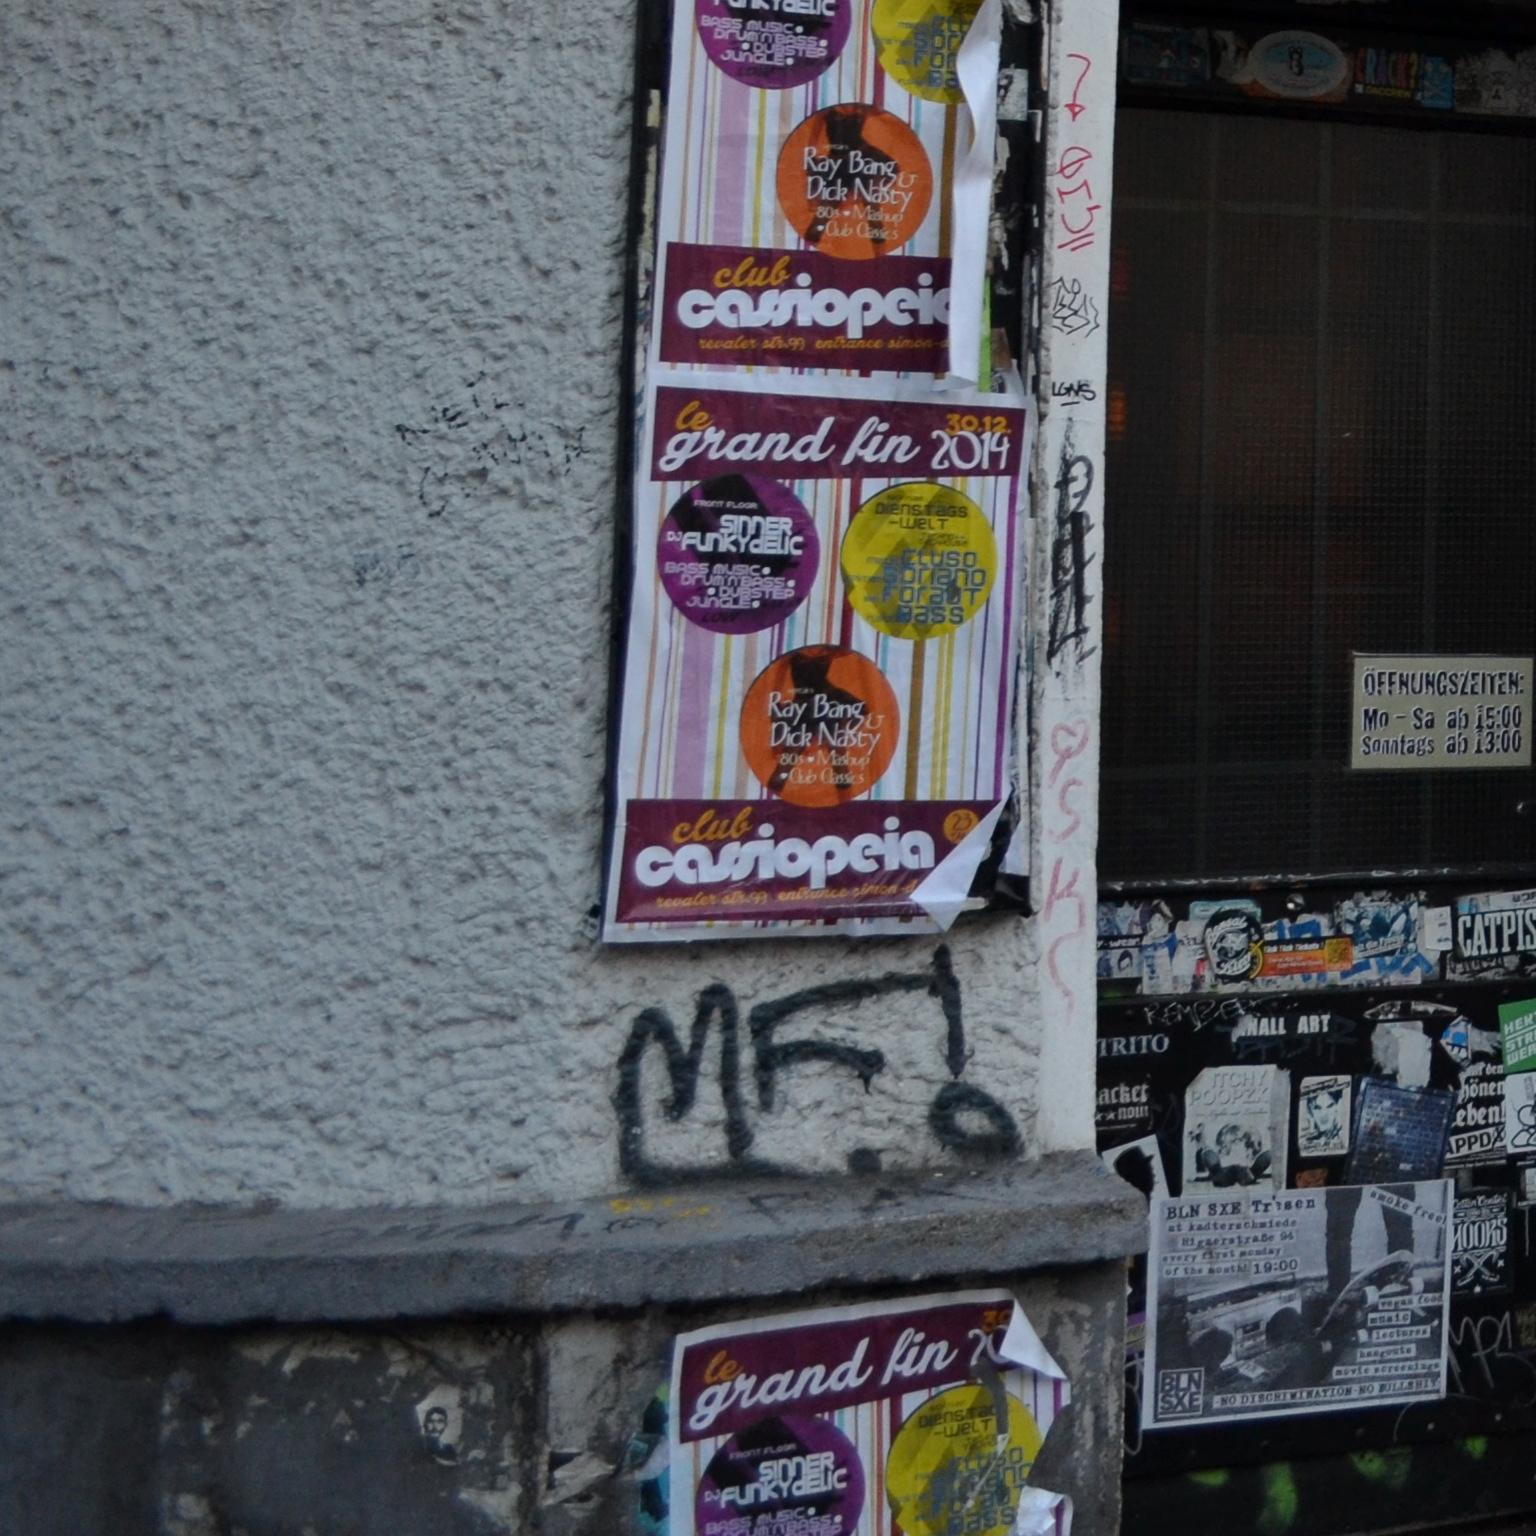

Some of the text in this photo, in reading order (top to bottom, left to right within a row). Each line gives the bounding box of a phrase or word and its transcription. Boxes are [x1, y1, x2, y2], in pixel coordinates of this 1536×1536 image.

[804, 146, 842, 174] Ray
[849, 150, 898, 186] Bang
[807, 175, 913, 212] Dick Nasty
[713, 254, 792, 288] club
[675, 400, 713, 431] le
[659, 416, 1011, 472] grand fin 2014
[720, 514, 793, 536] SINNER
[665, 561, 762, 576] BASS MUSIC
[686, 594, 753, 609] JUNGLE
[720, 586, 795, 601] DUBSTEP
[1363, 667, 1525, 696] ÖFFNUNGSZEITEN:
[769, 691, 864, 731] Ray Bang
[1362, 707, 1388, 731] Mo
[1413, 707, 1435, 730] Sa
[1447, 708, 1469, 730] ab
[1475, 705, 1522, 729] 15:00
[771, 721, 881, 757] Dick Nasty
[1361, 729, 1522, 757] Sonntags ab 13:00
[672, 806, 752, 844] club
[635, 816, 935, 889] cassiopeia
[1166, 1202, 1200, 1220] BLN
[1207, 1200, 1241, 1218] SXE
[1252, 1259, 1299, 1276] 19:00
[688, 1326, 960, 1431] grand fin
[704, 1349, 745, 1385] le
[1160, 1374, 1200, 1394] BLN
[1160, 1392, 1200, 1411] SXE
